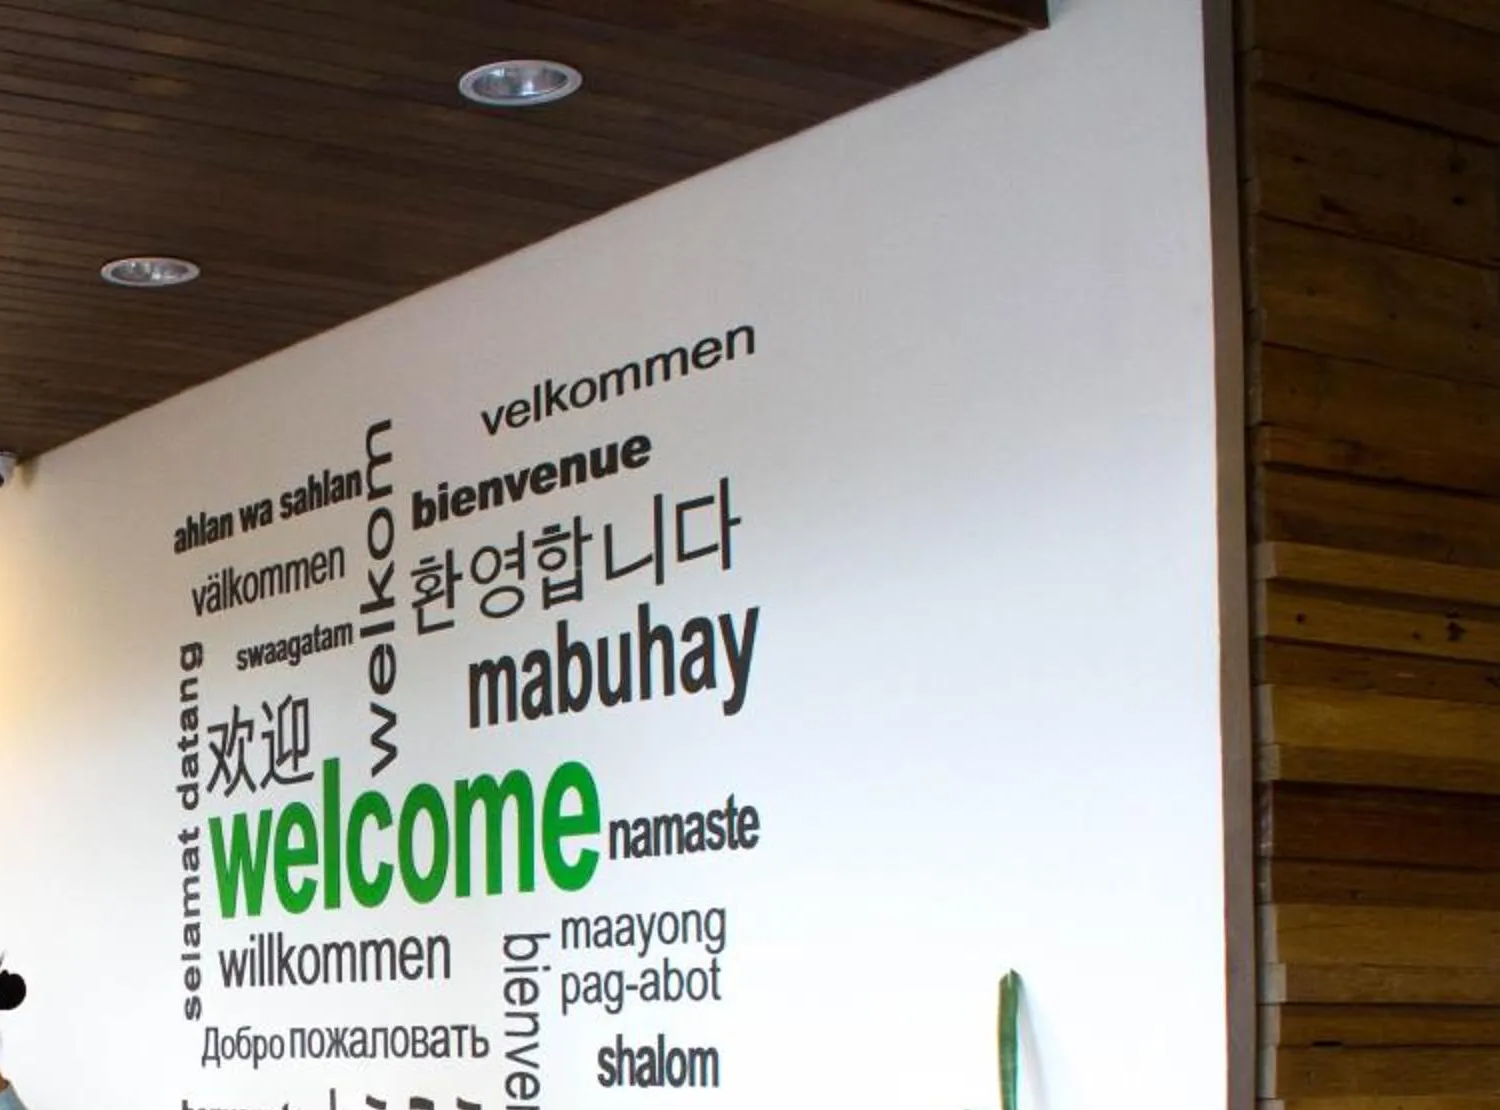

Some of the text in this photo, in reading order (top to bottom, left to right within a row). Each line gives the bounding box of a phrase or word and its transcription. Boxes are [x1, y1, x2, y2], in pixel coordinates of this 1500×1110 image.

[480, 324, 755, 437] velkommen
[173, 468, 363, 555] ahlan wa sahlan
[411, 434, 653, 531] bienvenue
[191, 545, 346, 617] välkommen
[359, 418, 398, 779] welkom
[409, 476, 742, 637] 환영합니다
[235, 621, 354, 672] swaagatam
[468, 601, 761, 729] mabuhay
[205, 693, 315, 799] 欢迎
[175, 641, 205, 1021] selamat datang
[207, 756, 601, 919] welcome
[608, 793, 761, 861] namaste
[218, 931, 451, 988] willkommen
[561, 907, 726, 959] maayong
[561, 957, 722, 1016] pag-abot
[201, 1024, 490, 1070] Добро пожаловать
[597, 1033, 720, 1089] shalom
